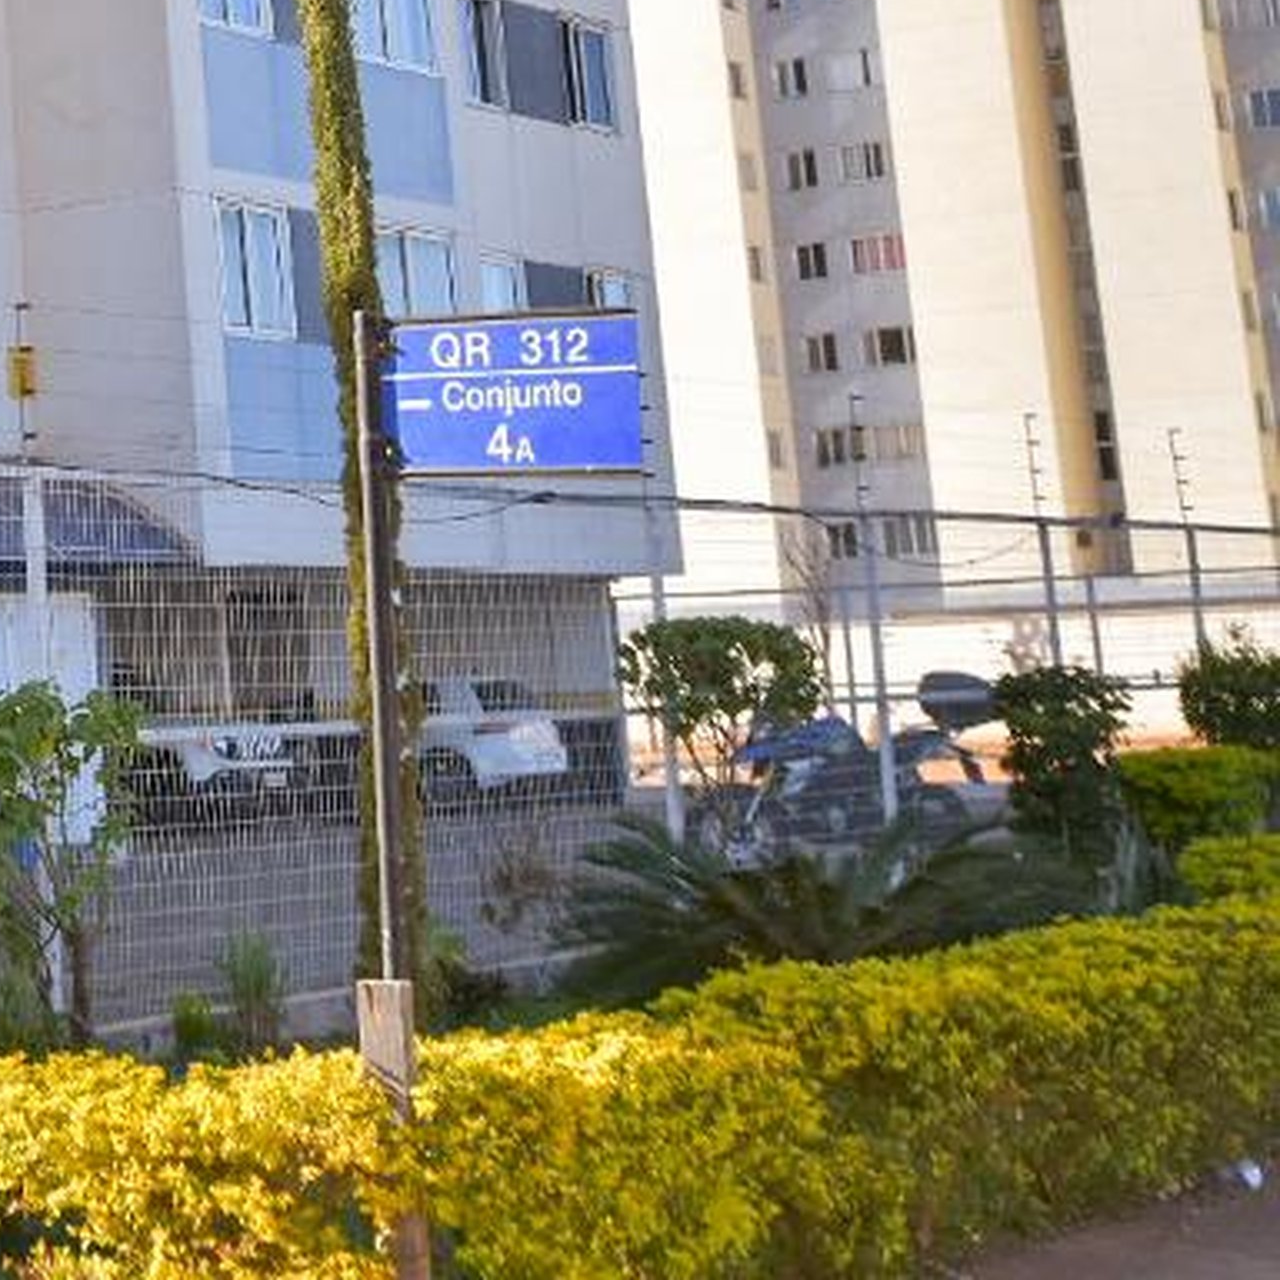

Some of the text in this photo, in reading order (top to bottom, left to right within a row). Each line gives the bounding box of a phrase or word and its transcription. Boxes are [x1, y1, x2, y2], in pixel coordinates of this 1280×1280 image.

[430, 327, 589, 368] QR 312
[441, 378, 583, 415] Conjunto
